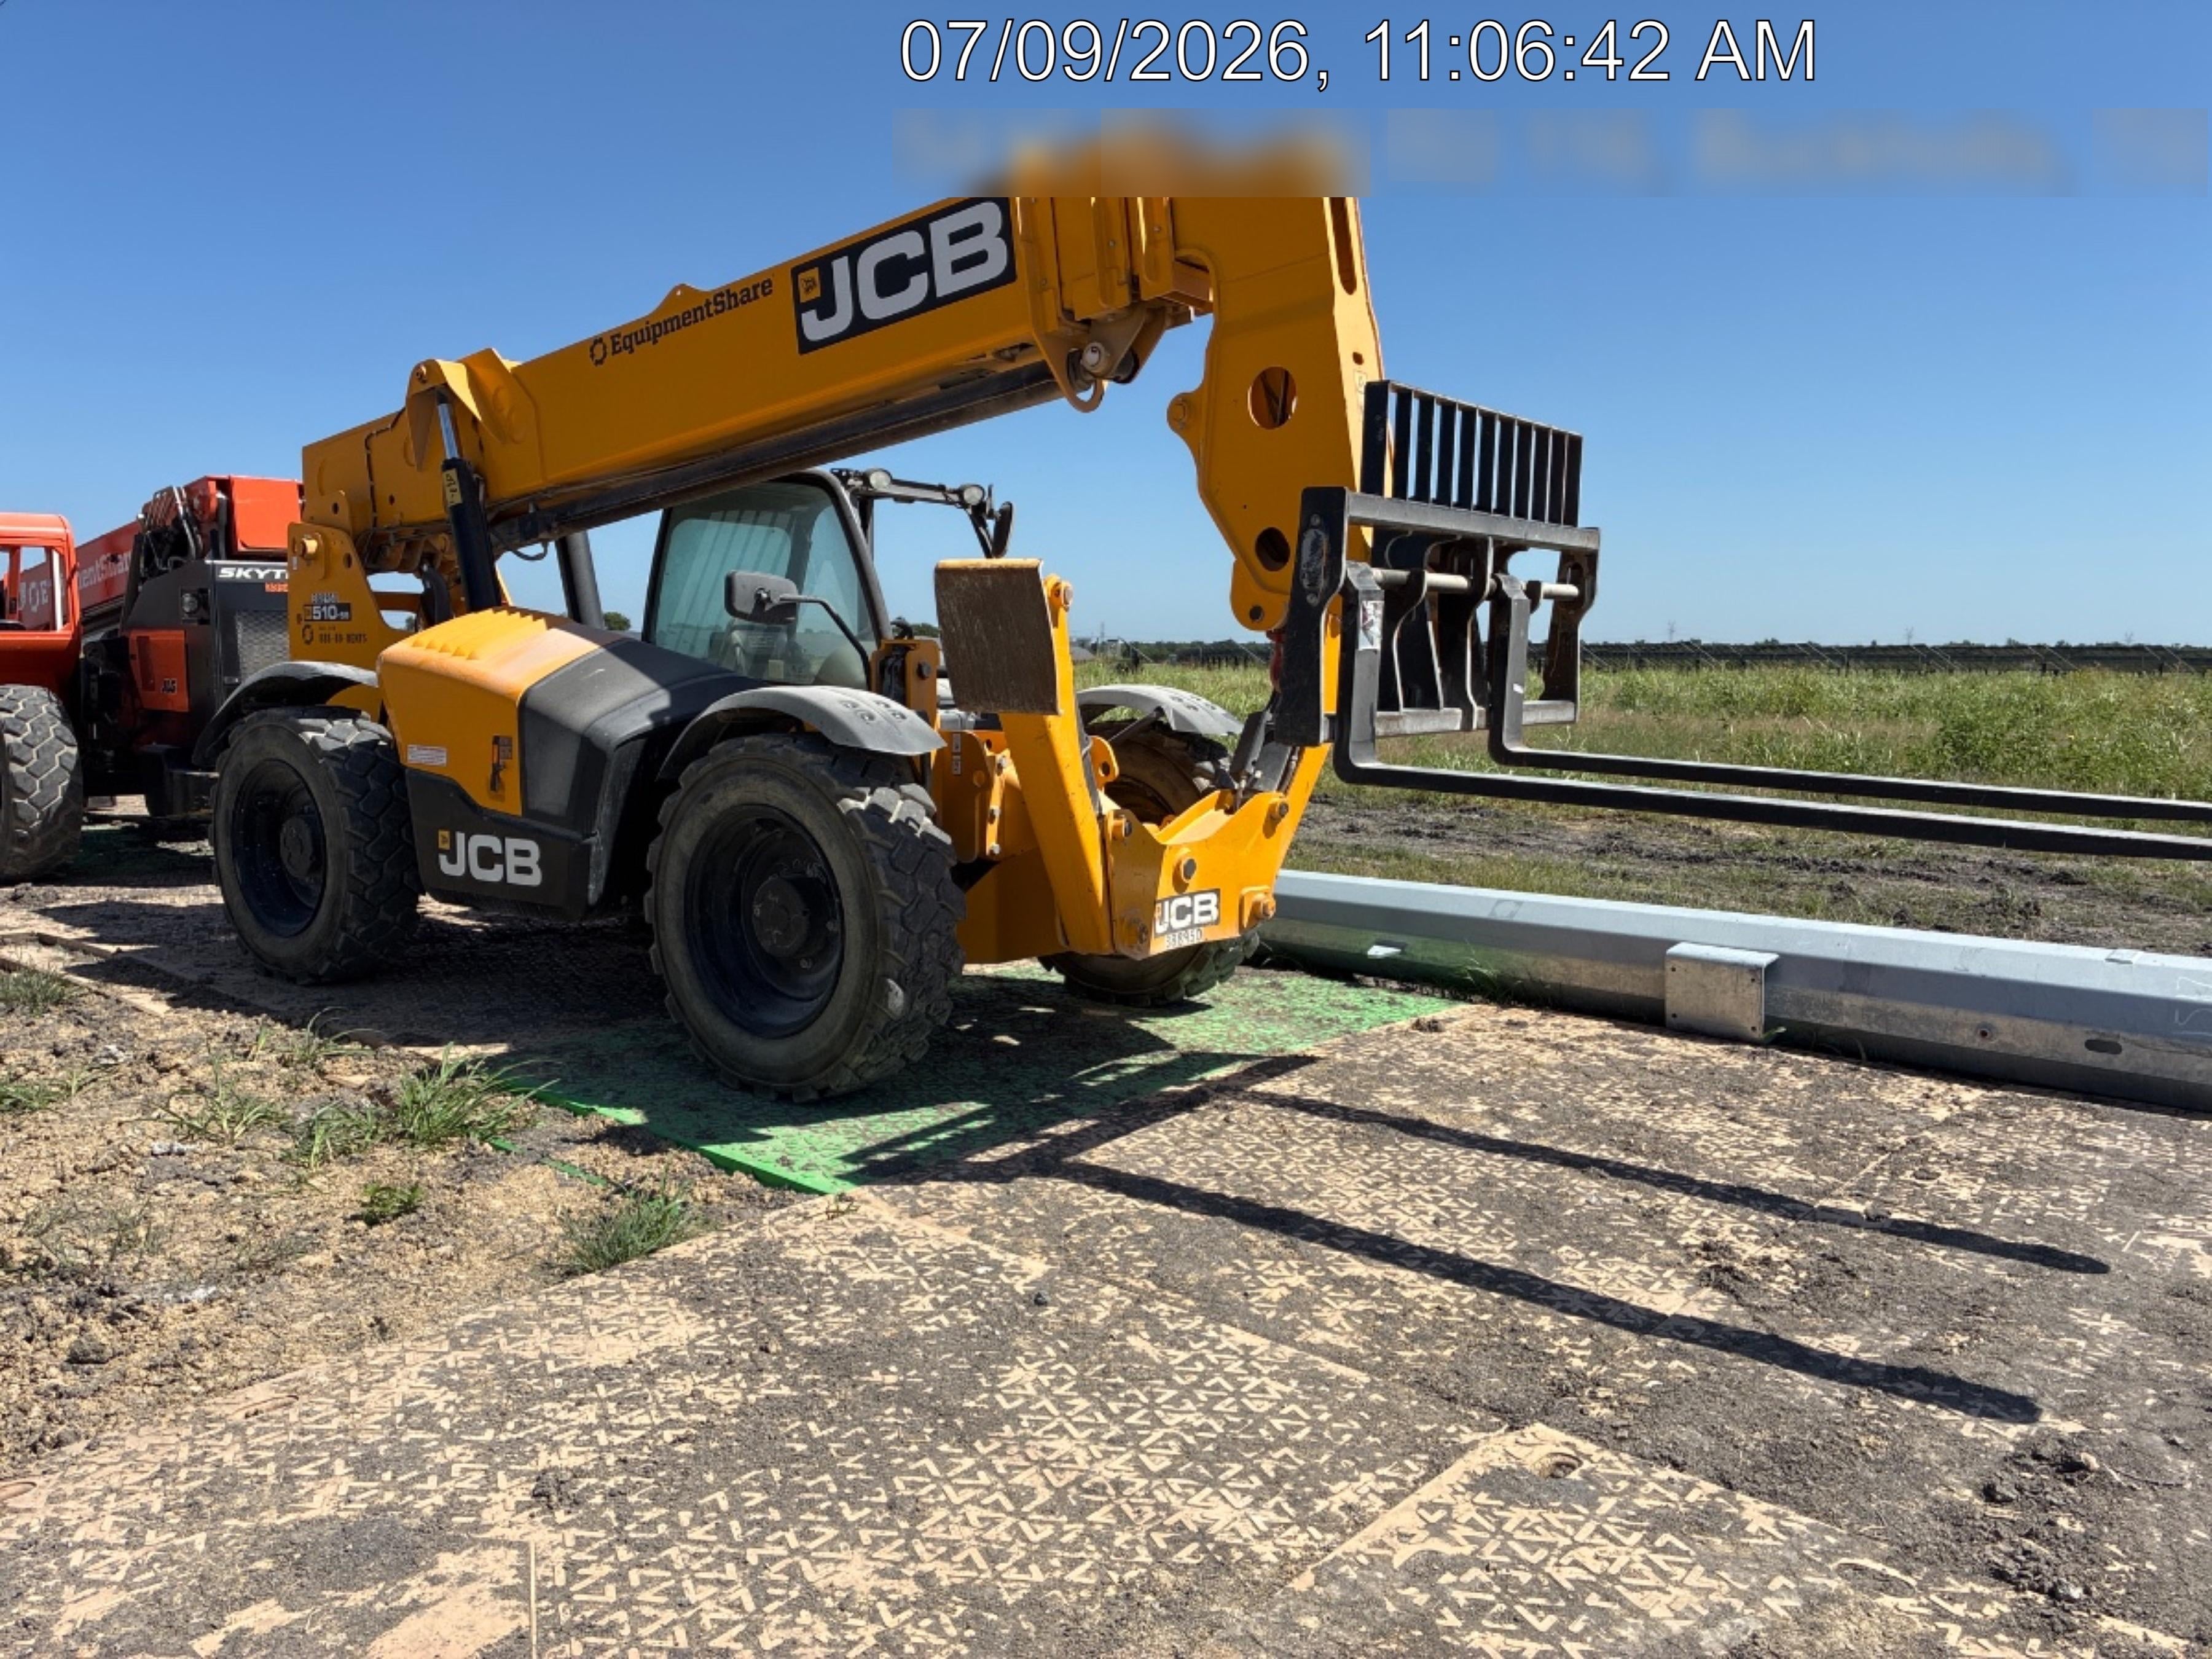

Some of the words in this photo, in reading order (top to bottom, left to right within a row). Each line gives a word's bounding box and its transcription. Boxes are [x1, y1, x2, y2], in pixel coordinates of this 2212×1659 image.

[801, 202, 1008, 342] JCB
[611, 276, 774, 356] EquipmentShare
[219, 567, 288, 579] SKYT
[438, 831, 543, 887] JCB
[1155, 892, 1219, 934] JCB
